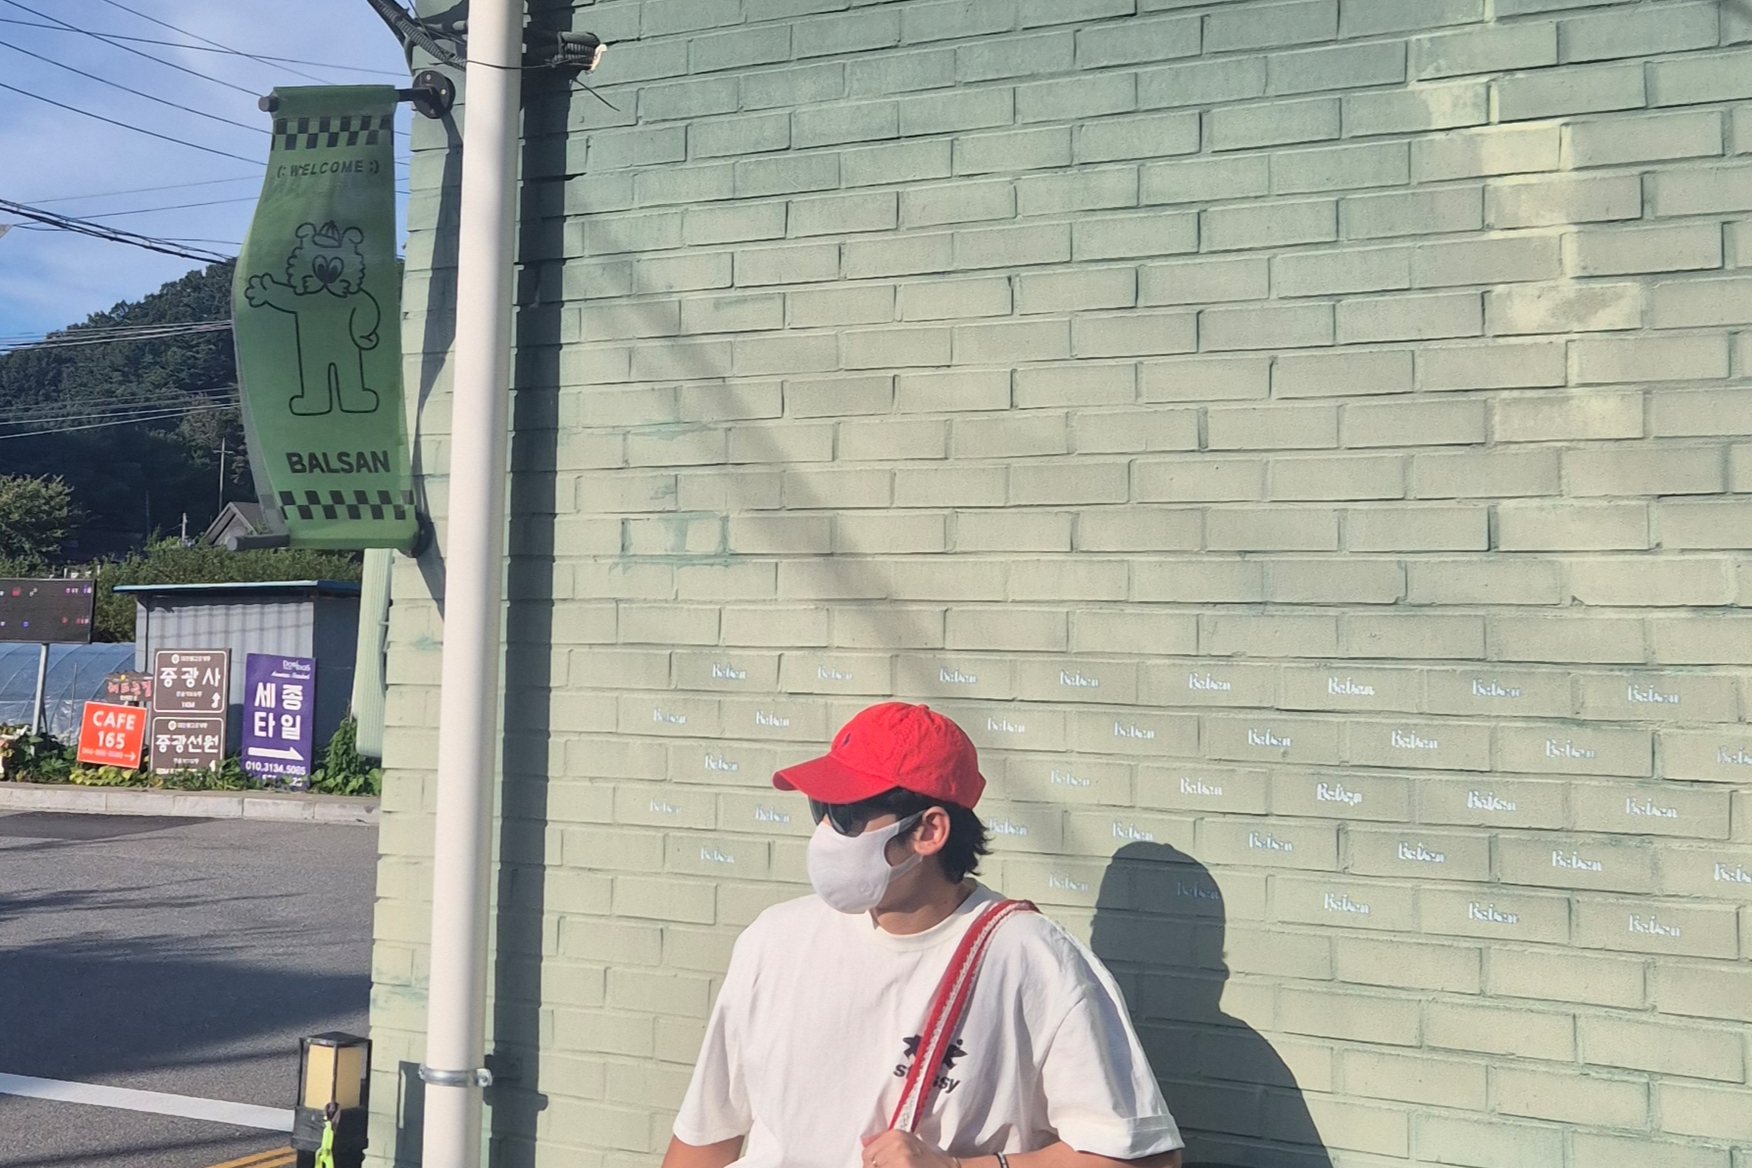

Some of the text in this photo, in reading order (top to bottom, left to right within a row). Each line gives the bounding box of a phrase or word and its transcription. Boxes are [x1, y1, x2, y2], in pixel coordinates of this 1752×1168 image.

[290, 160, 364, 177] WELCOME
[285, 450, 391, 474] BALSAN
[254, 682, 303, 710] 세종
[92, 710, 136, 730] CAFE
[254, 711, 301, 740] 타일
[97, 730, 125, 750] 165
